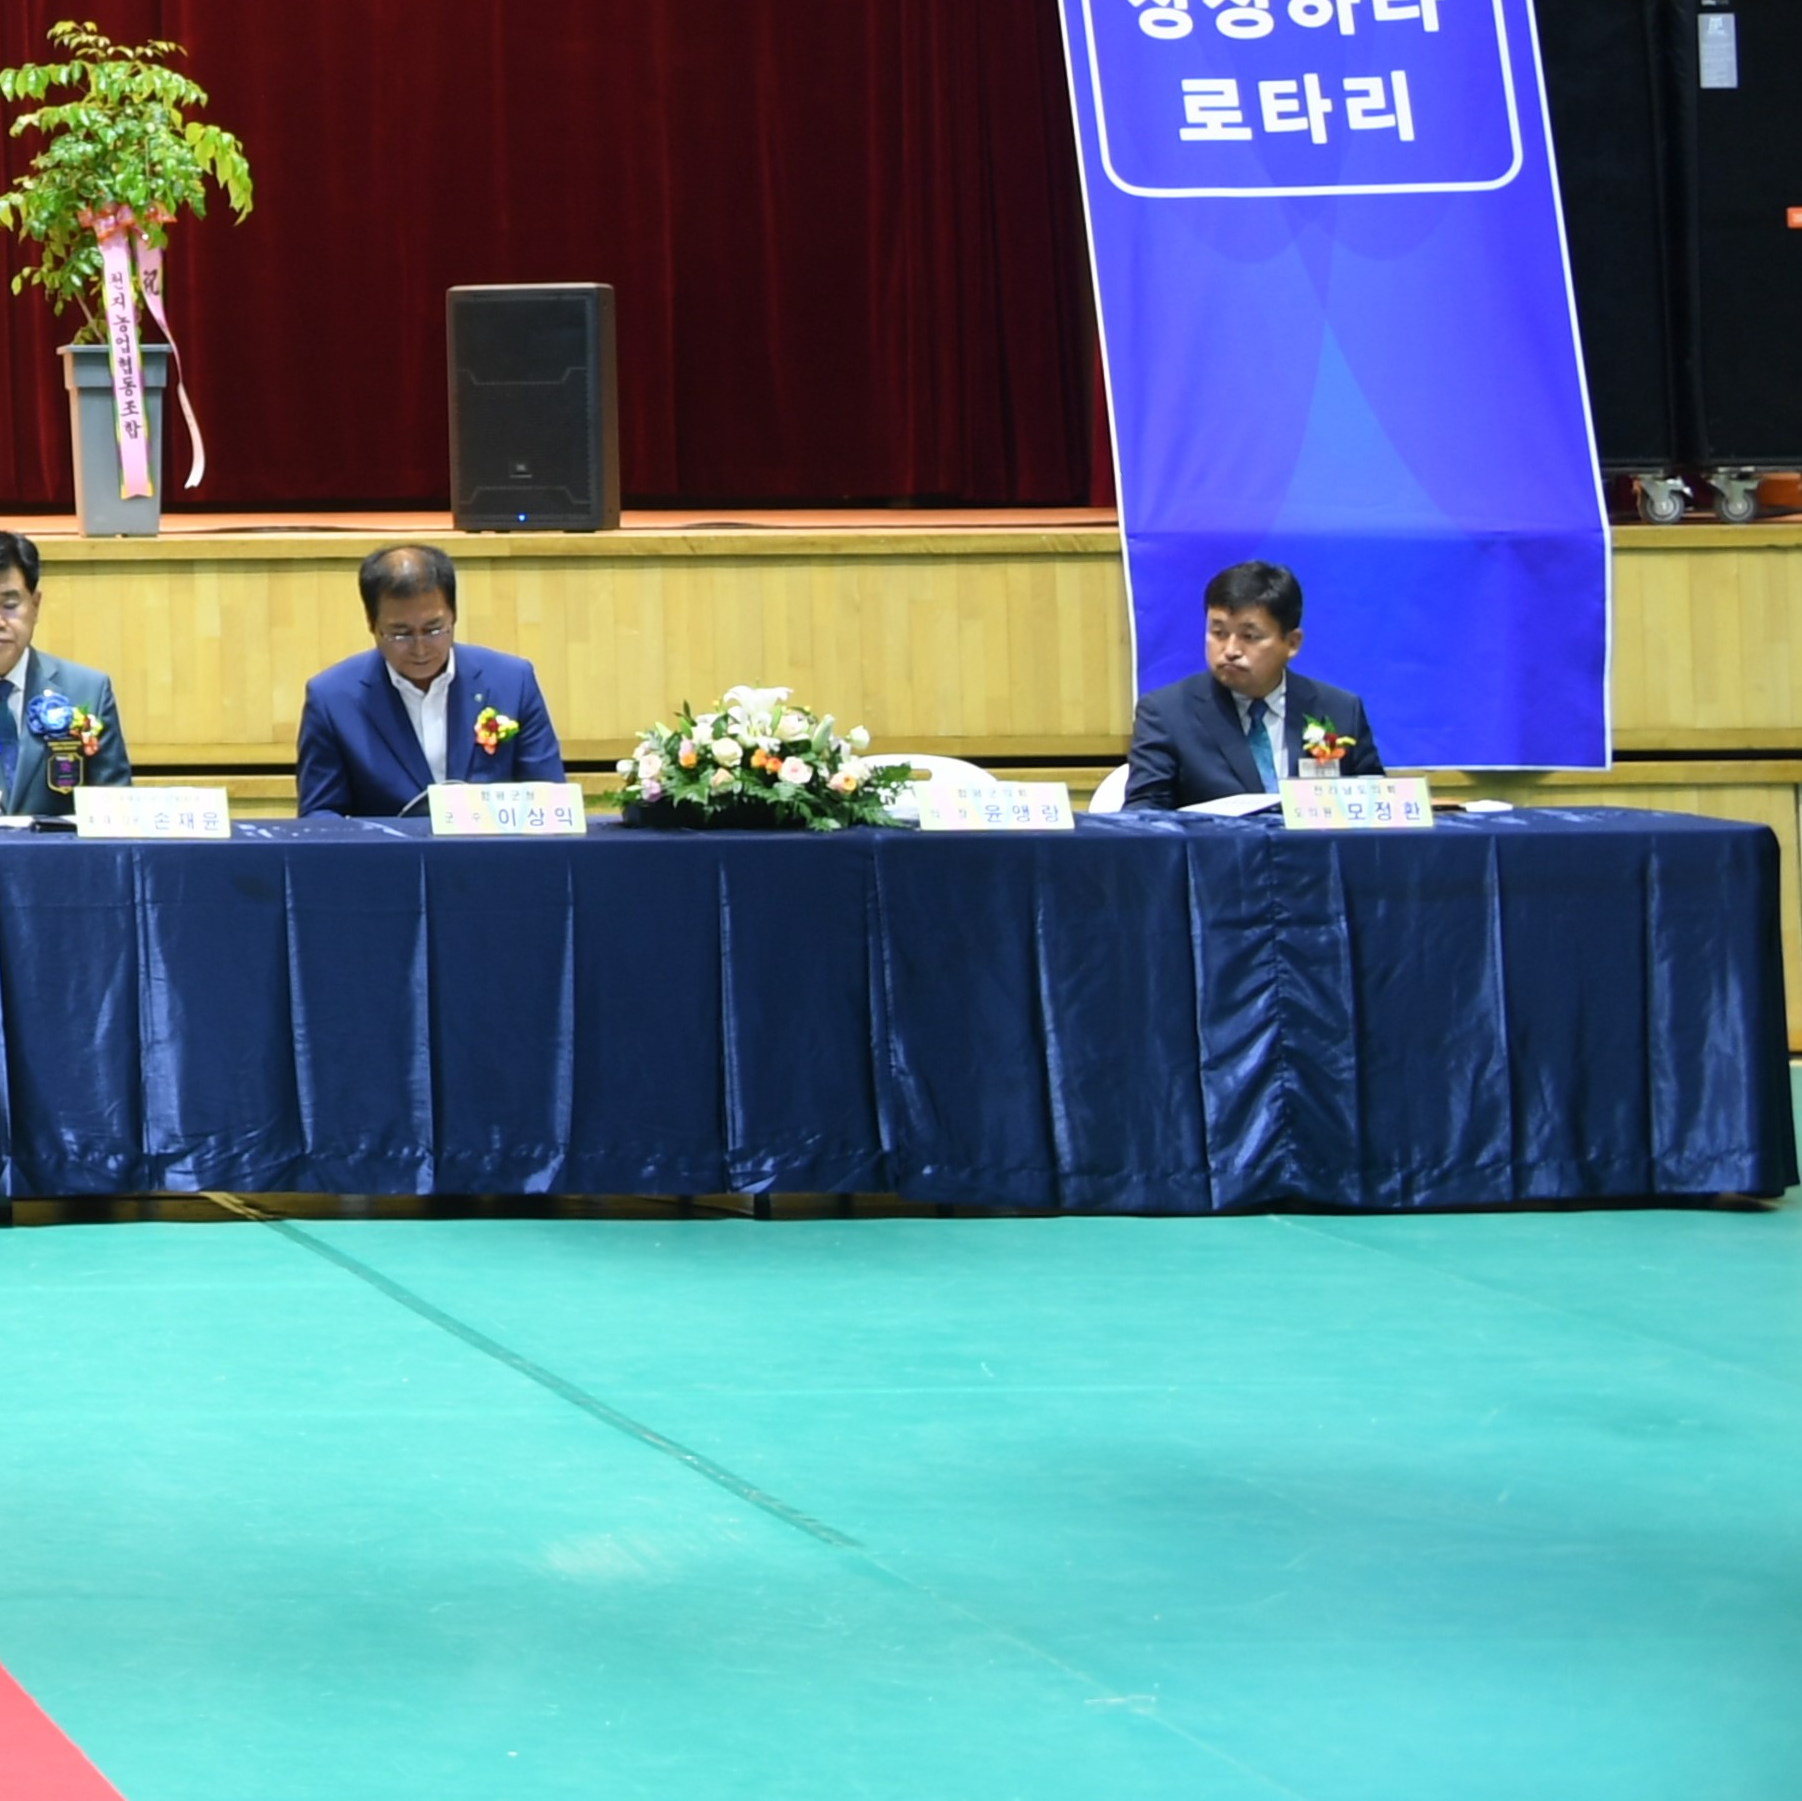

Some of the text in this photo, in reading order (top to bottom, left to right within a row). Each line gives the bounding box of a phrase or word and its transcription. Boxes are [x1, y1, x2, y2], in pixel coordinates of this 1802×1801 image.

[1177, 70, 1417, 146] 로타리
[142, 269, 160, 297] 祝
[497, 806, 574, 828] 이상익
[1346, 800, 1421, 822] 모정환
